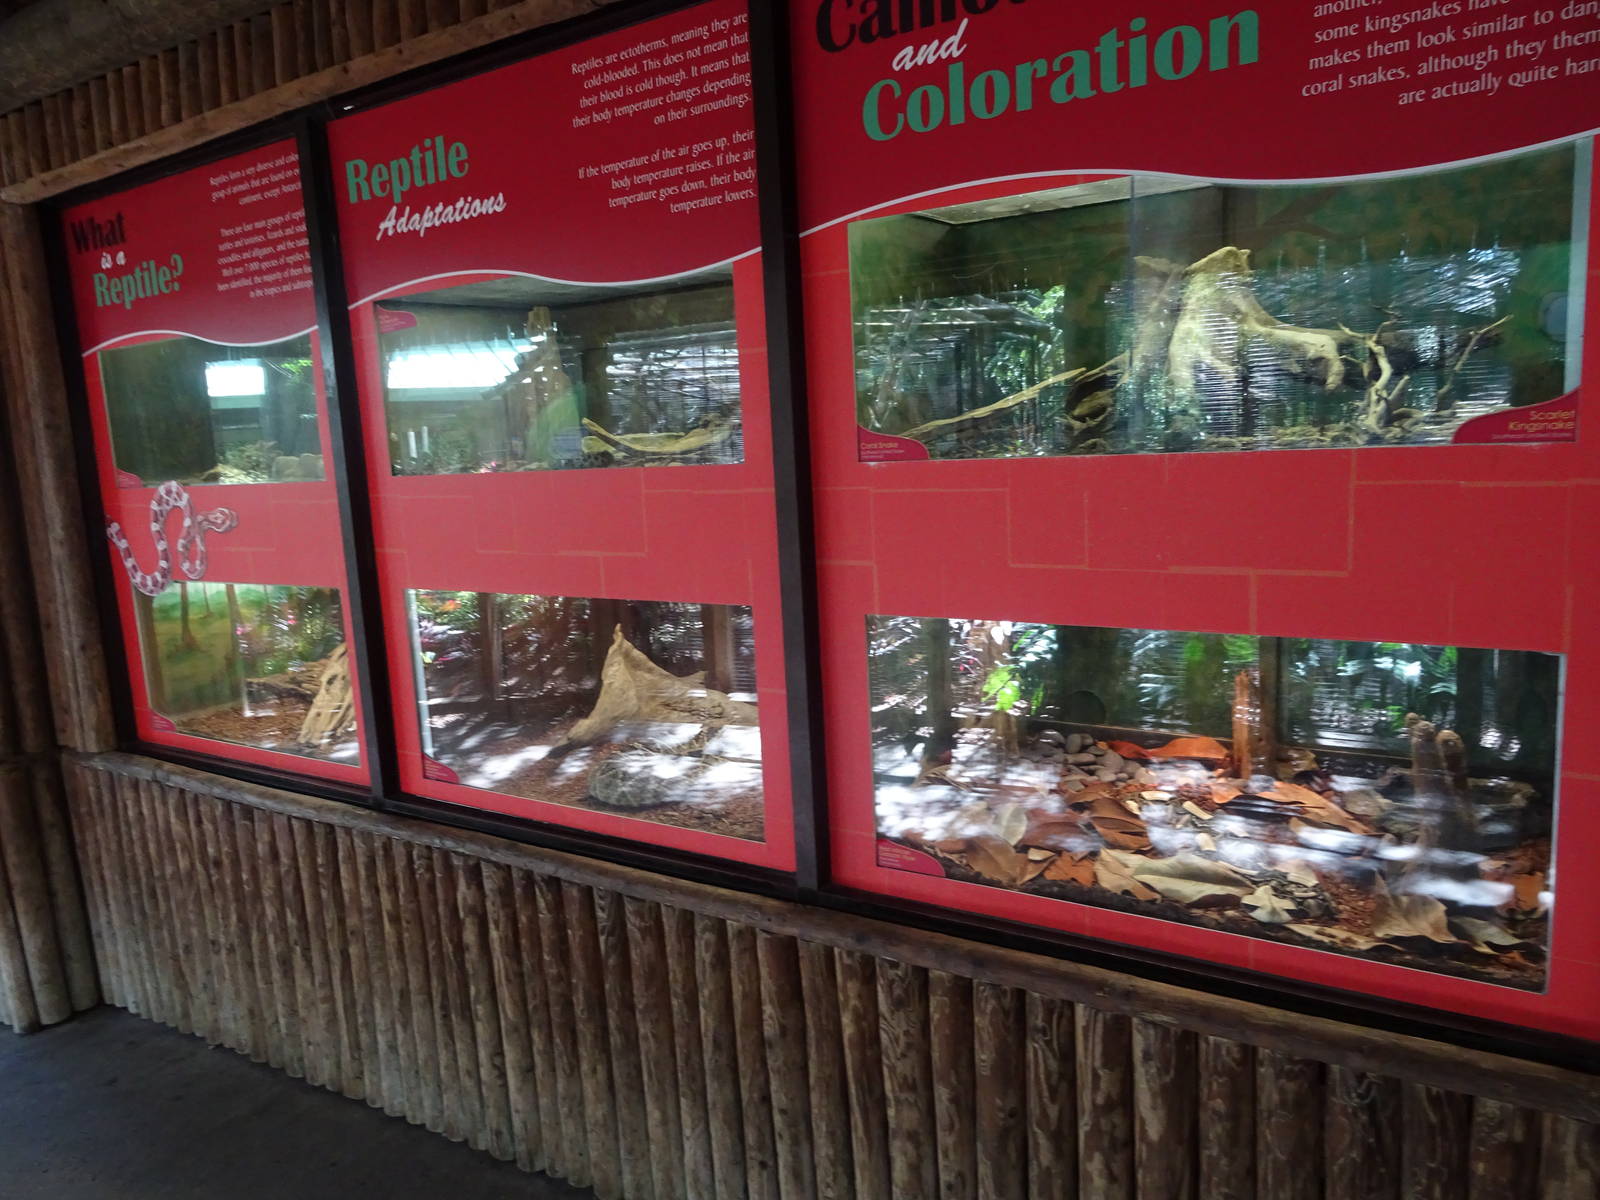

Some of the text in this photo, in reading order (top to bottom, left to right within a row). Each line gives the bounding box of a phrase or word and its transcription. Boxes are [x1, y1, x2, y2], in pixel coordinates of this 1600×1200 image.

[571, 57, 604, 75] Reptiles
[605, 53, 619, 65] are
[671, 26, 709, 44] meaning
[711, 19, 730, 34] they
[733, 13, 748, 25] are
[892, 18, 969, 71] and
[1309, 0, 1600, 70] makes them look similar to dan
[1314, 23, 1359, 43] some
[1365, 0, 1461, 33] kingsnakes
[579, 52, 750, 109] their blood is cold though. It means that
[584, 32, 748, 89] cold-blooded. This does not mean that
[862, 9, 1259, 142] Coloration
[1302, 74, 1342, 97] coral
[1417, 45, 1498, 75] although
[1505, 40, 1547, 60] they
[572, 72, 752, 128] their body temperature changes depending
[654, 92, 752, 126] on their surroundings.
[1398, 87, 1425, 105] are
[1432, 72, 1502, 97] actually
[345, 135, 469, 204] Reptile
[578, 167, 586, 179] If
[586, 165, 599, 178] the
[600, 153, 649, 174] temperature
[651, 150, 660, 162] of
[662, 147, 676, 161] the
[678, 143, 690, 157] air
[692, 139, 713, 158] goes
[732, 129, 755, 144] their
[611, 149, 755, 191] body temperature raises. If the air
[608, 188, 656, 209] temperature
[659, 184, 679, 201] goes
[710, 172, 730, 187] their
[733, 166, 757, 184] body
[670, 187, 757, 215] temperature lowers.
[70, 211, 126, 255] What
[376, 191, 507, 241] Adaptations
[93, 253, 183, 309] Reptile?
[1508, 421, 1576, 433] Kingsnake
